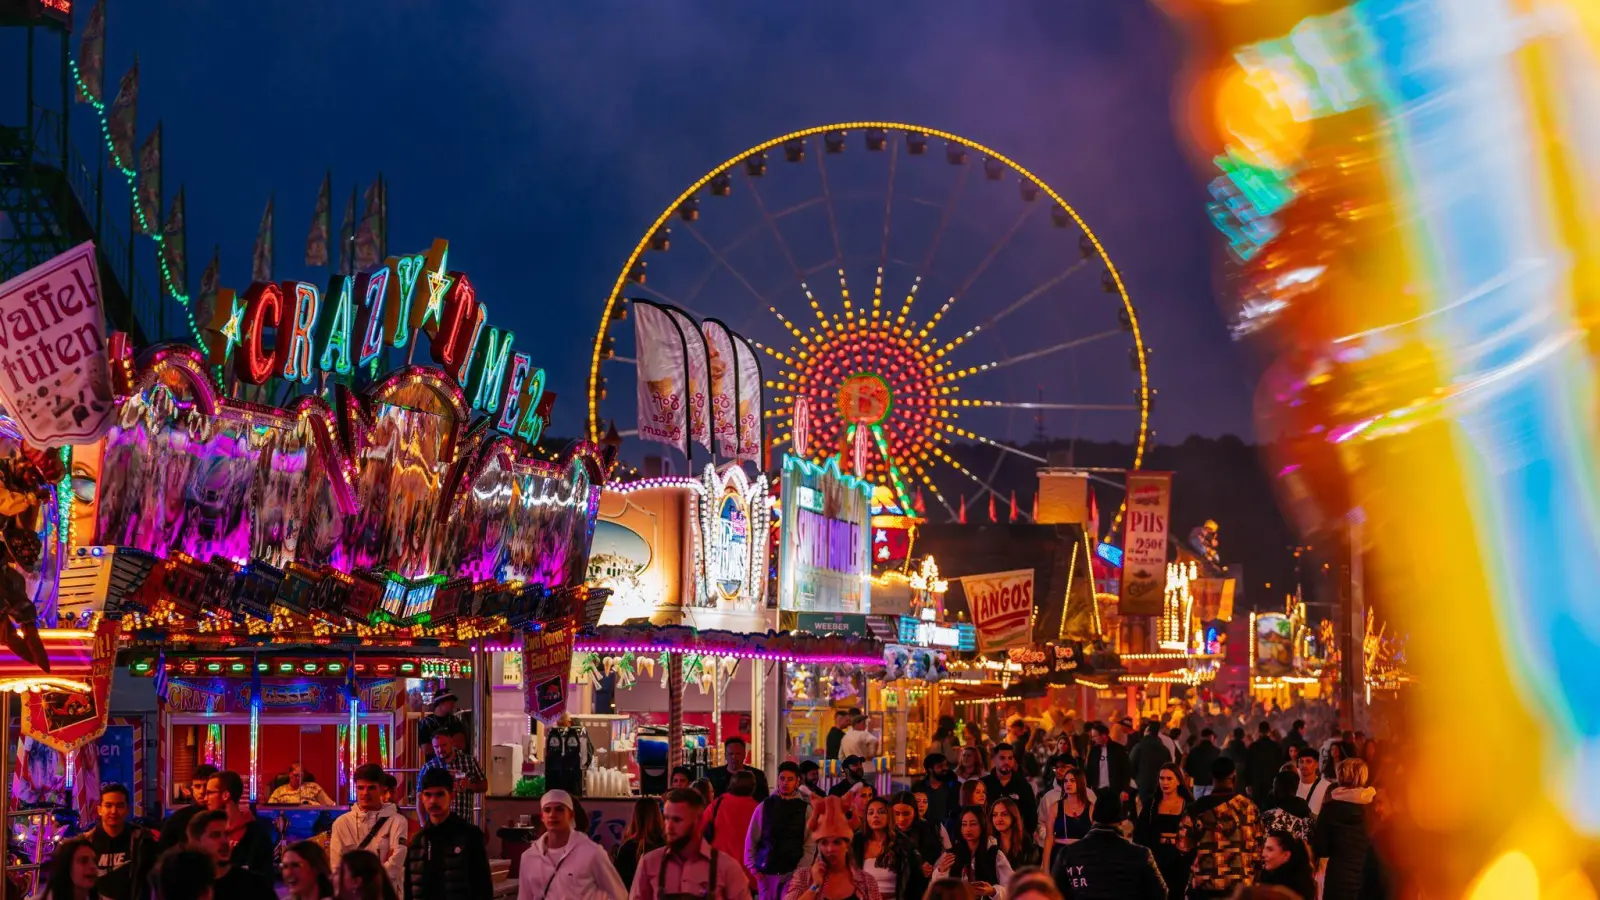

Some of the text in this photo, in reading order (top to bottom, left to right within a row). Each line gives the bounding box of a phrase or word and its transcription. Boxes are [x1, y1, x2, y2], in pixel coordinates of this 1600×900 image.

[248, 254, 425, 385] CRAZY
[1, 322, 104, 393] tüten
[1131, 511, 1164, 533] Pils
[169, 685, 222, 711] CRAZY
